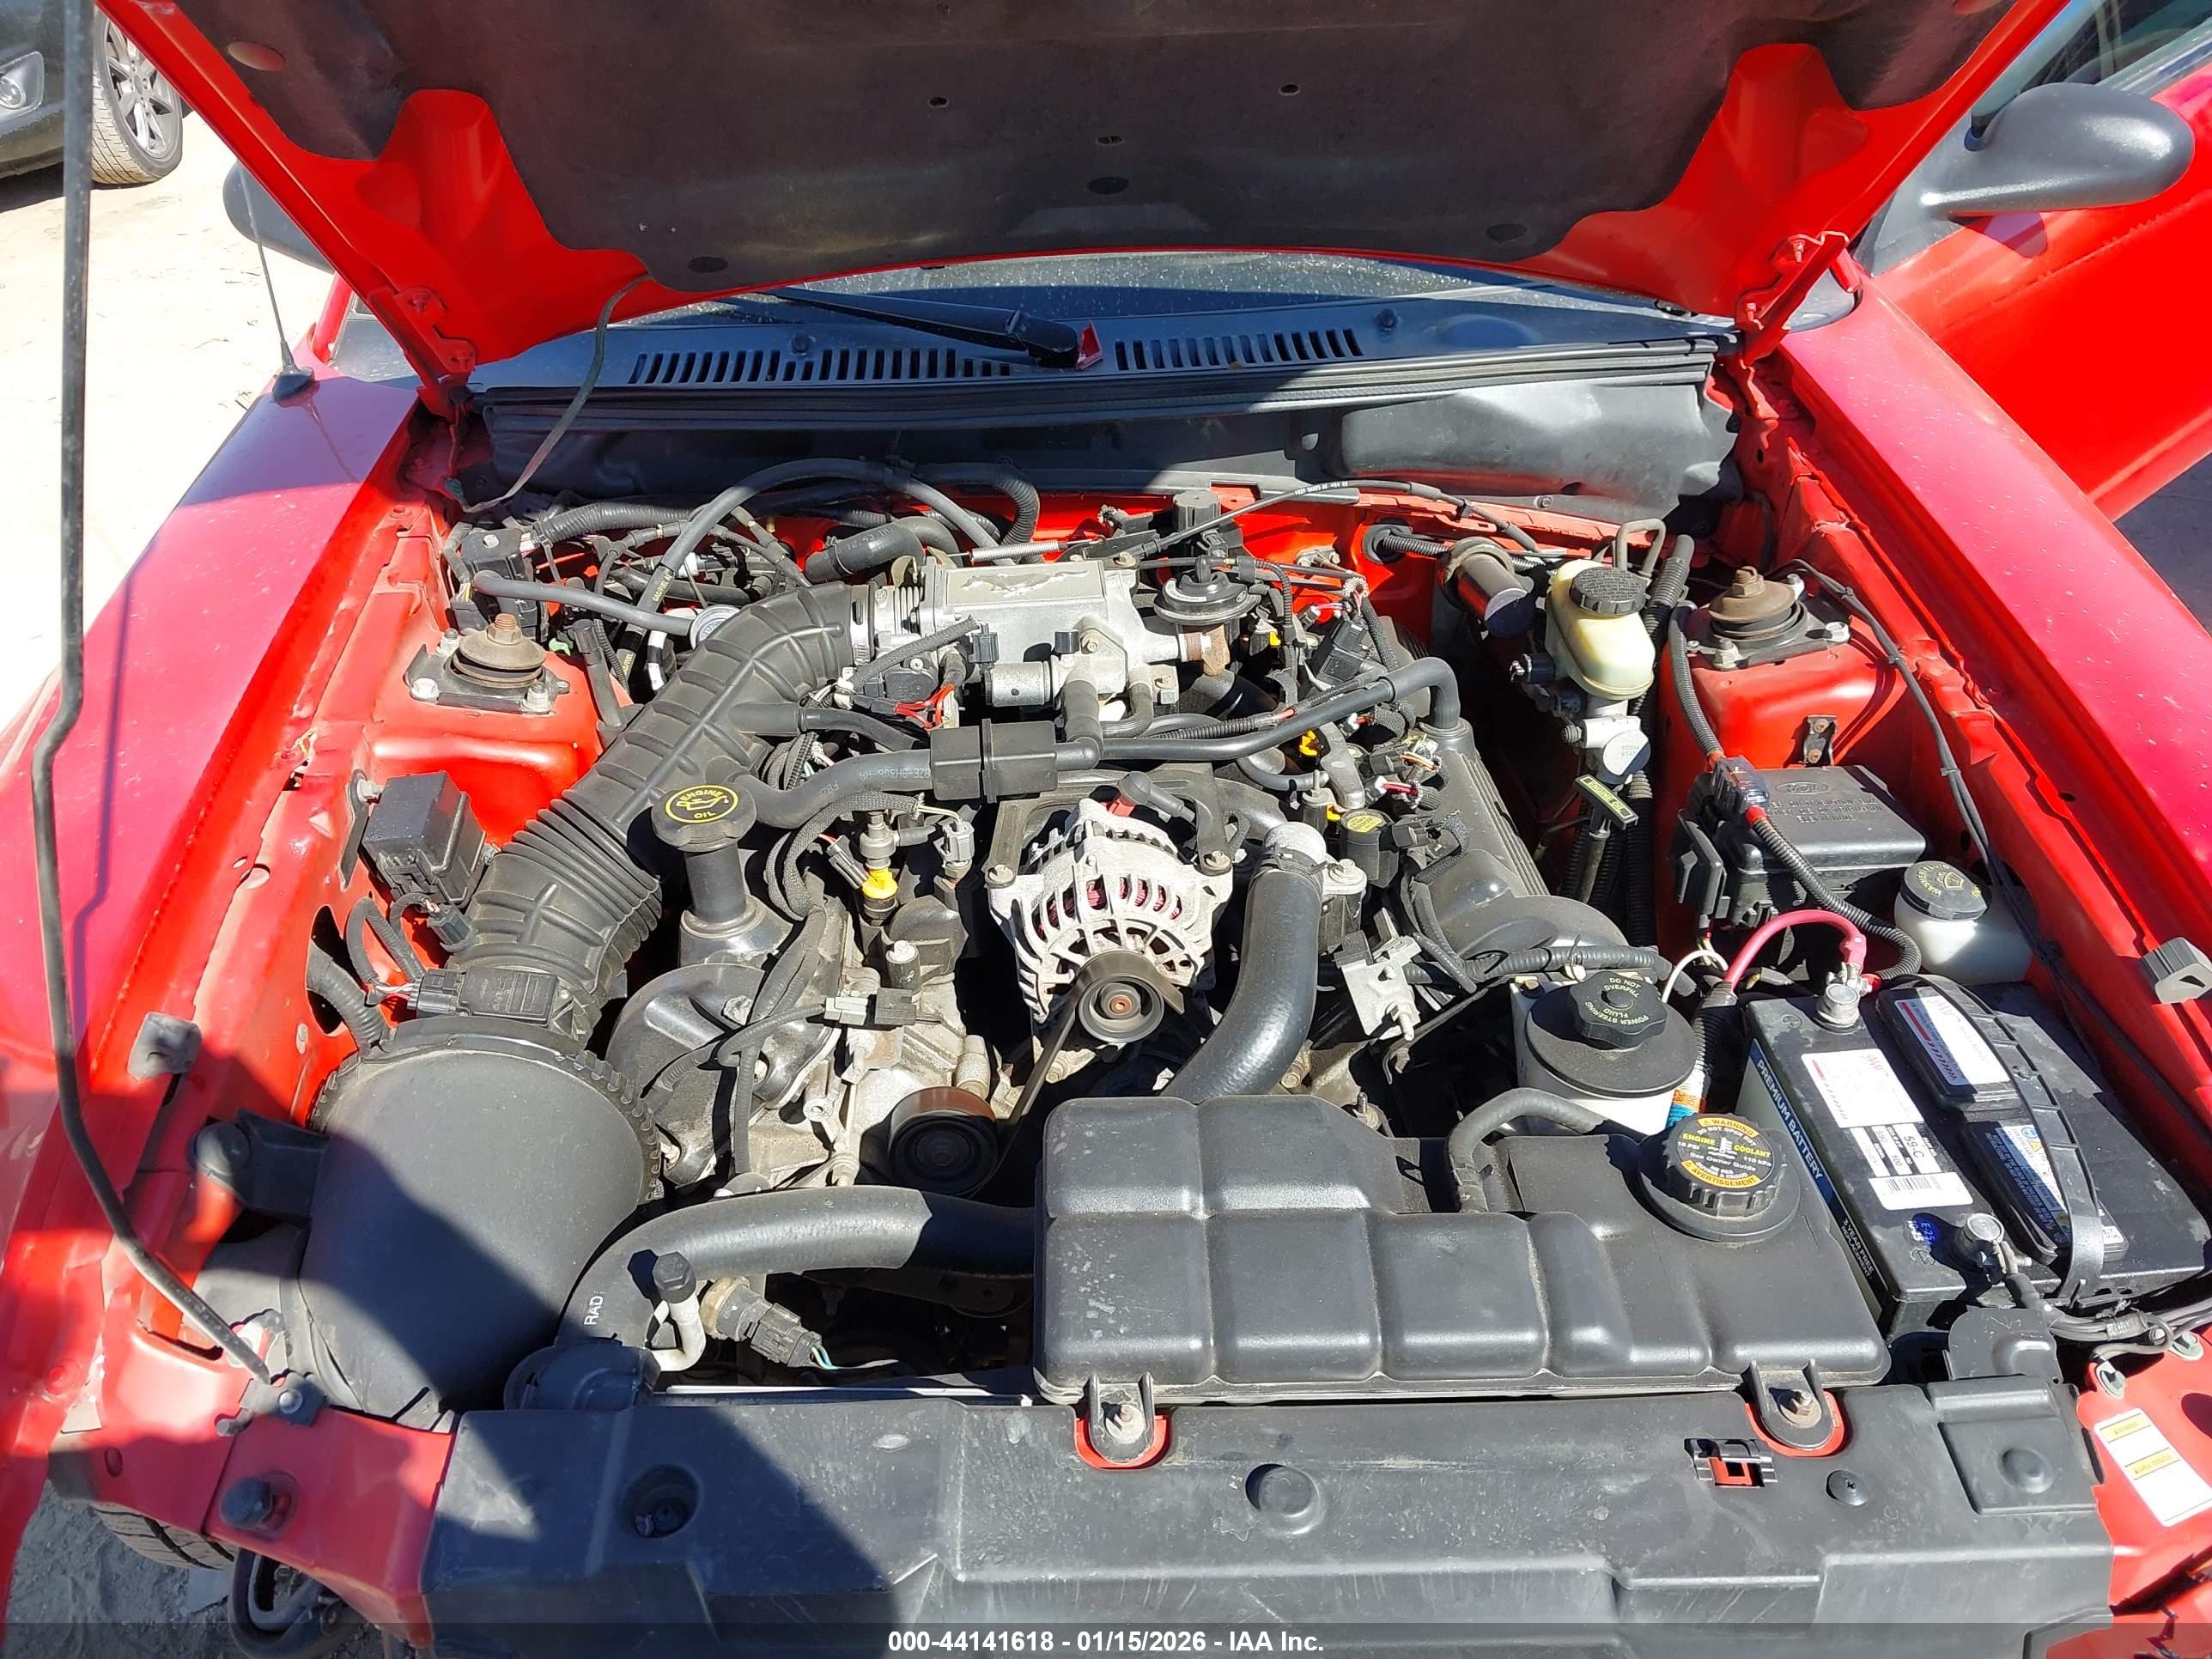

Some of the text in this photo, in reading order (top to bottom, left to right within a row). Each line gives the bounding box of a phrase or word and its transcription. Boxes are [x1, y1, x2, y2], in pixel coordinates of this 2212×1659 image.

[679, 789, 725, 801] ENGINE
[1588, 781, 1625, 812] ENGINE OIL
[1603, 983, 1640, 998] OVERFILL
[1623, 980, 1641, 989] NOT
[1584, 1001, 1650, 1025] POWER STEERING
[1603, 1008, 1629, 1018] FLUID
[1711, 1119, 1754, 1136] WARNING
[1757, 1059, 1824, 1180] PREMIUM BATTERY
[1697, 1127, 1707, 1135] DO
[1723, 1127, 1744, 1137] OPEN
[1682, 1133, 1771, 1158] ENGINE COOLANT
[1904, 1134, 1925, 1158] 59-C
[1706, 1156, 1732, 1165] Owner
[1733, 1162, 1757, 1171] Guide
[1691, 1167, 1756, 1186] AVERTISSEMENT
[1846, 1225, 1862, 1250] YEAR
[1859, 1249, 1875, 1273] FREE
[584, 1296, 604, 1325] RAD
